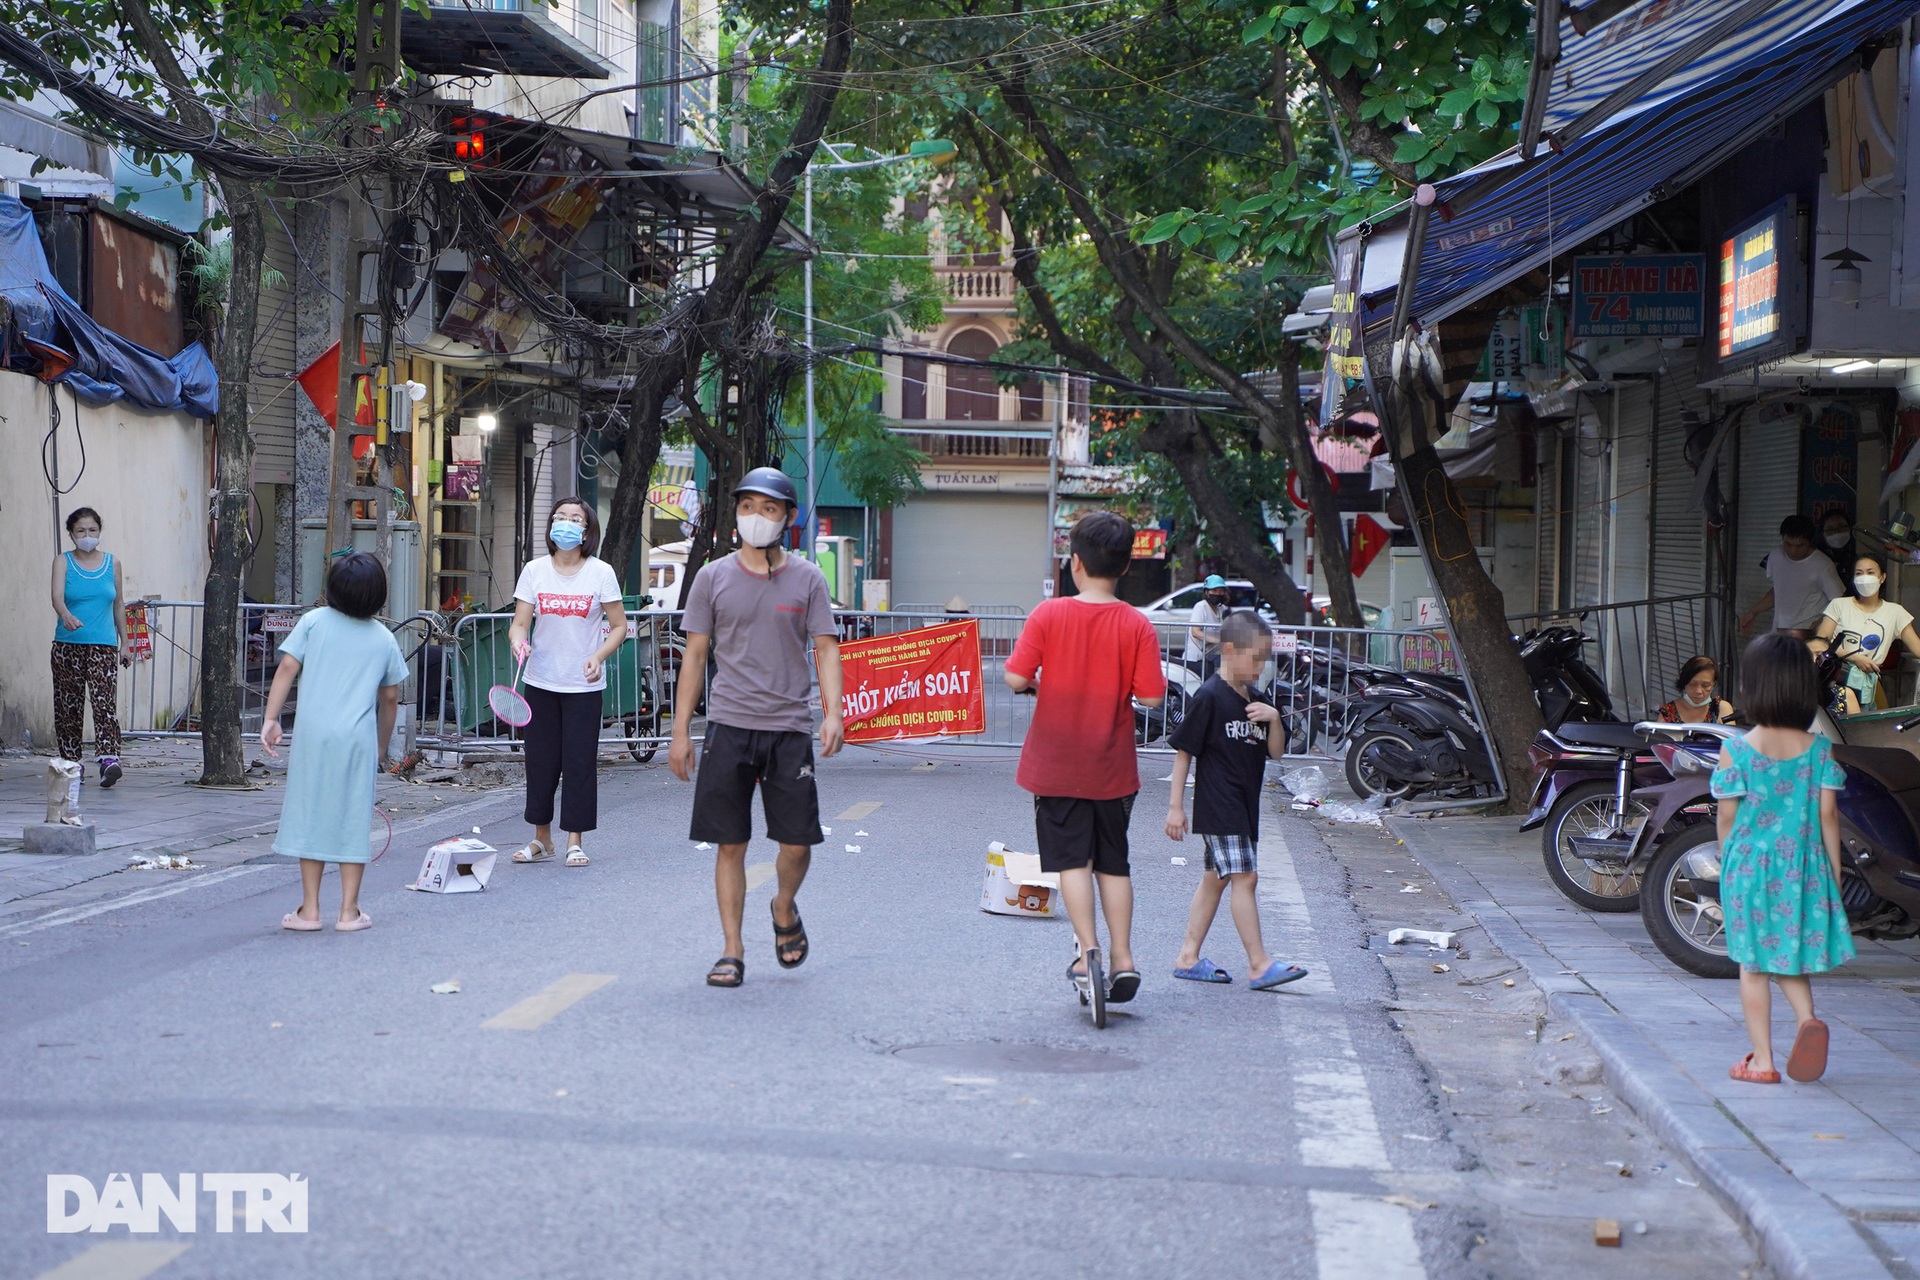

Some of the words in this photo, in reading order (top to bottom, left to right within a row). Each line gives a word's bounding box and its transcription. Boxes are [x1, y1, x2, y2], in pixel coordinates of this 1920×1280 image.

[1580, 259, 1660, 294] THẮNG
[1665, 261, 1700, 293] HÀ
[1586, 295, 1633, 322] 74
[1635, 304, 1664, 321] HÀNG
[1665, 307, 1695, 321] KHOAI
[972, 474, 998, 484] LAN
[852, 650, 866, 659] HUY
[883, 670, 921, 708] KIỂM
[924, 665, 971, 697] SOÁT
[870, 711, 900, 729] CHỐNG
[902, 712, 925, 727] DỊCH
[926, 708, 968, 723] COVID-19
